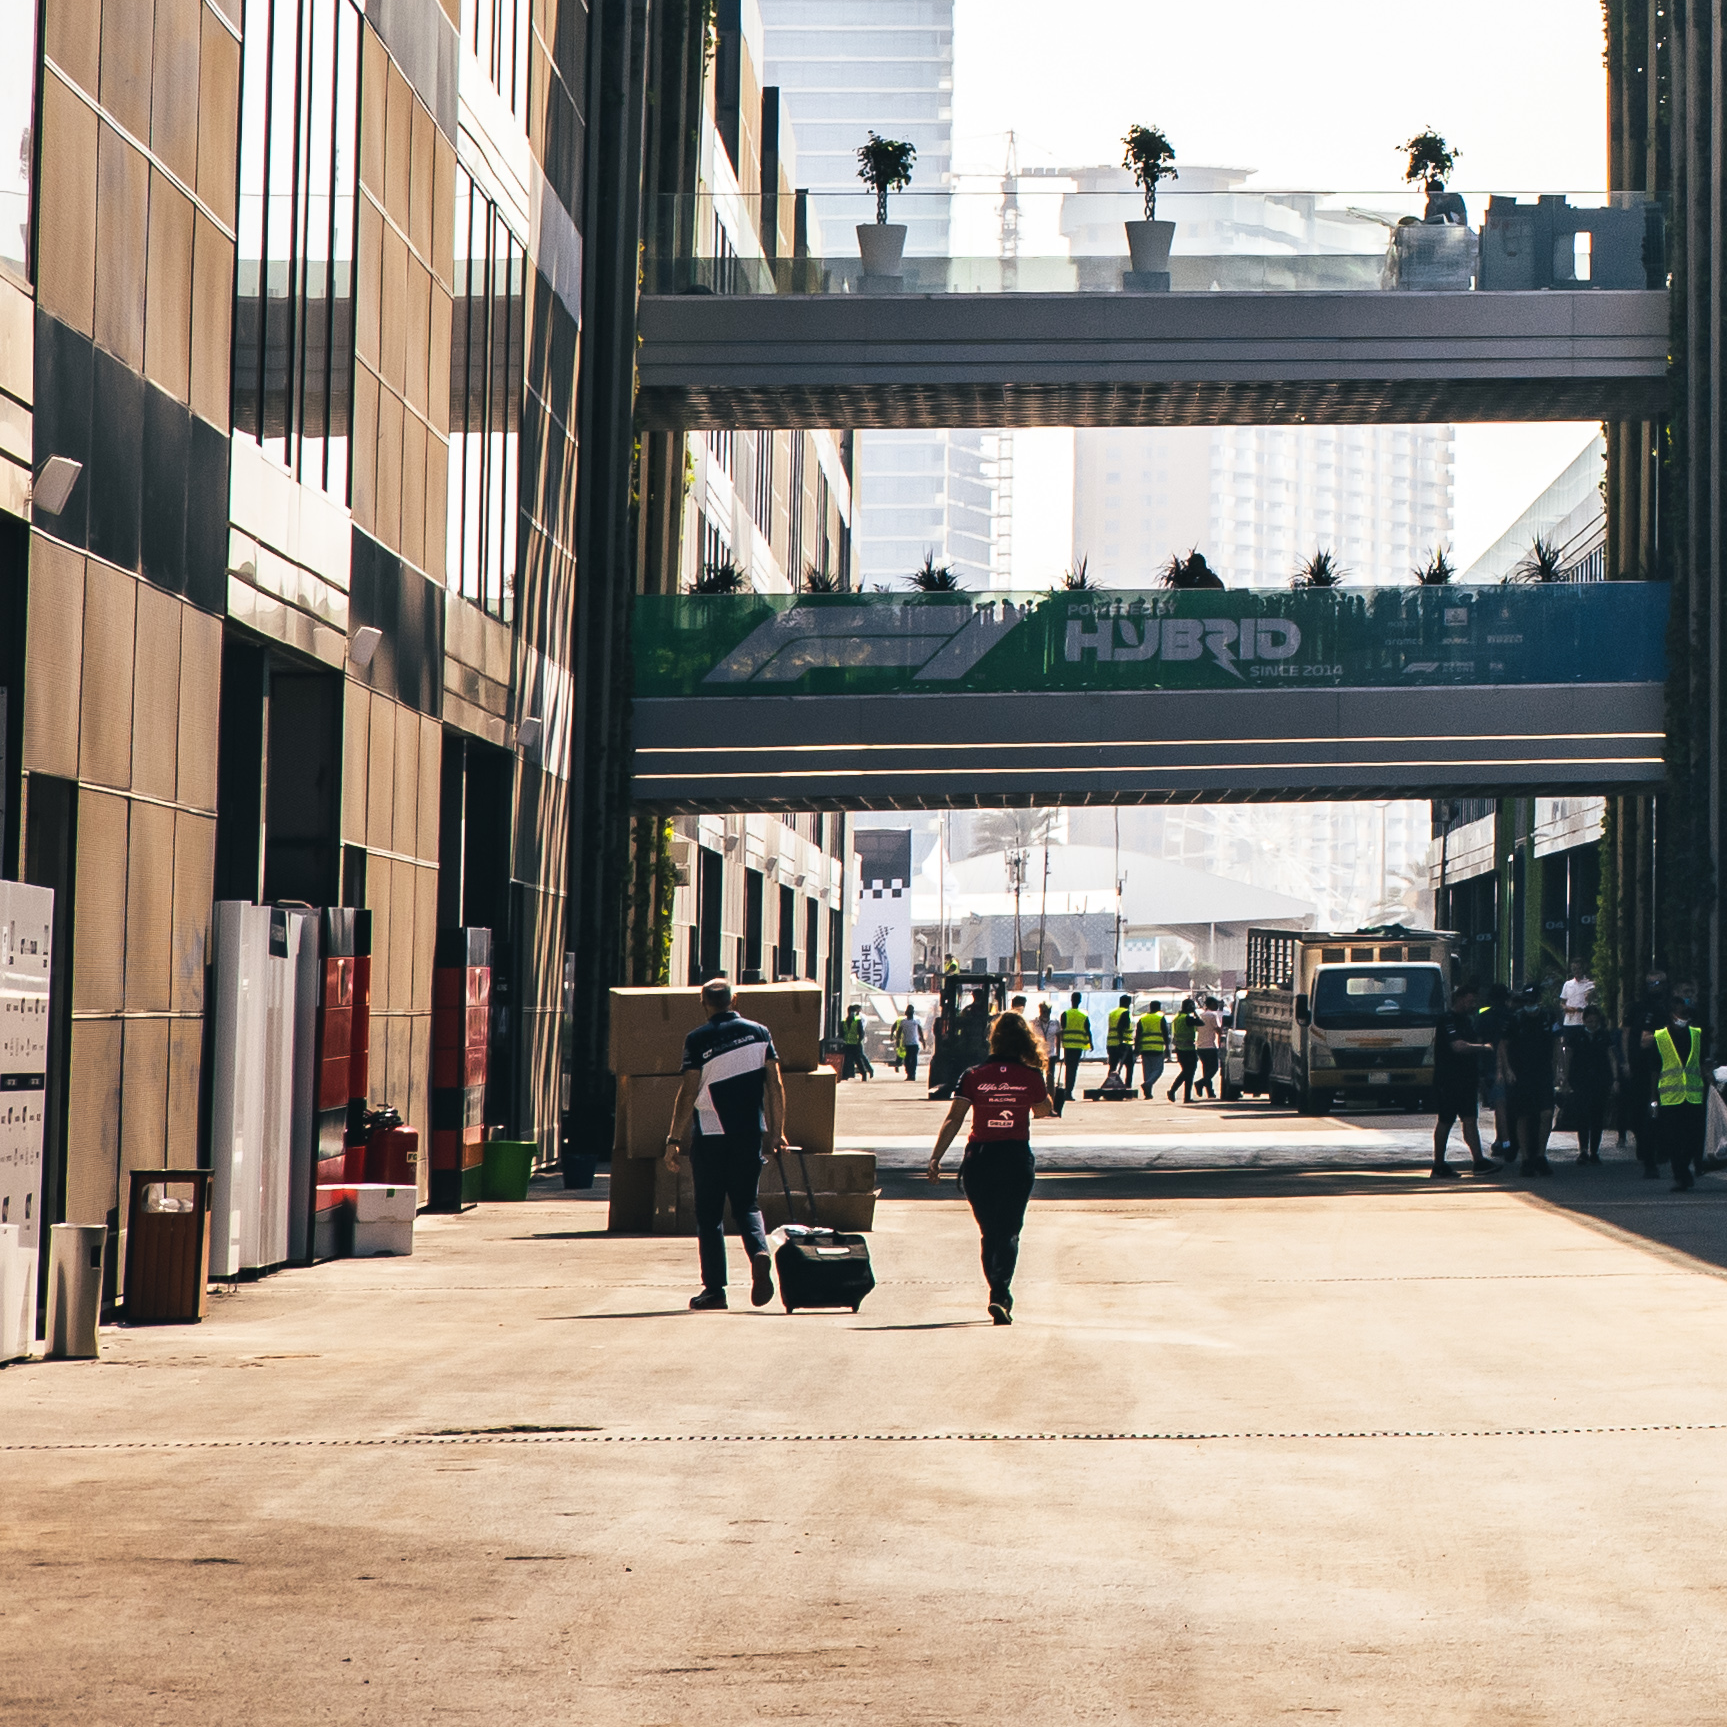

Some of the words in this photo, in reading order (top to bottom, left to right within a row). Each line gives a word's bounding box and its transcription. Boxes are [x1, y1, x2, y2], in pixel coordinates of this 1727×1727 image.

[1067, 603, 1152, 616] POWERED
[1157, 603, 1177, 615] BY
[1064, 618, 1301, 671] HYBRID
[1249, 665, 1299, 677] SINCE
[1302, 664, 1344, 677] 2014
[977, 1083, 997, 1093] Alfa
[998, 1082, 1028, 1091] Romeo
